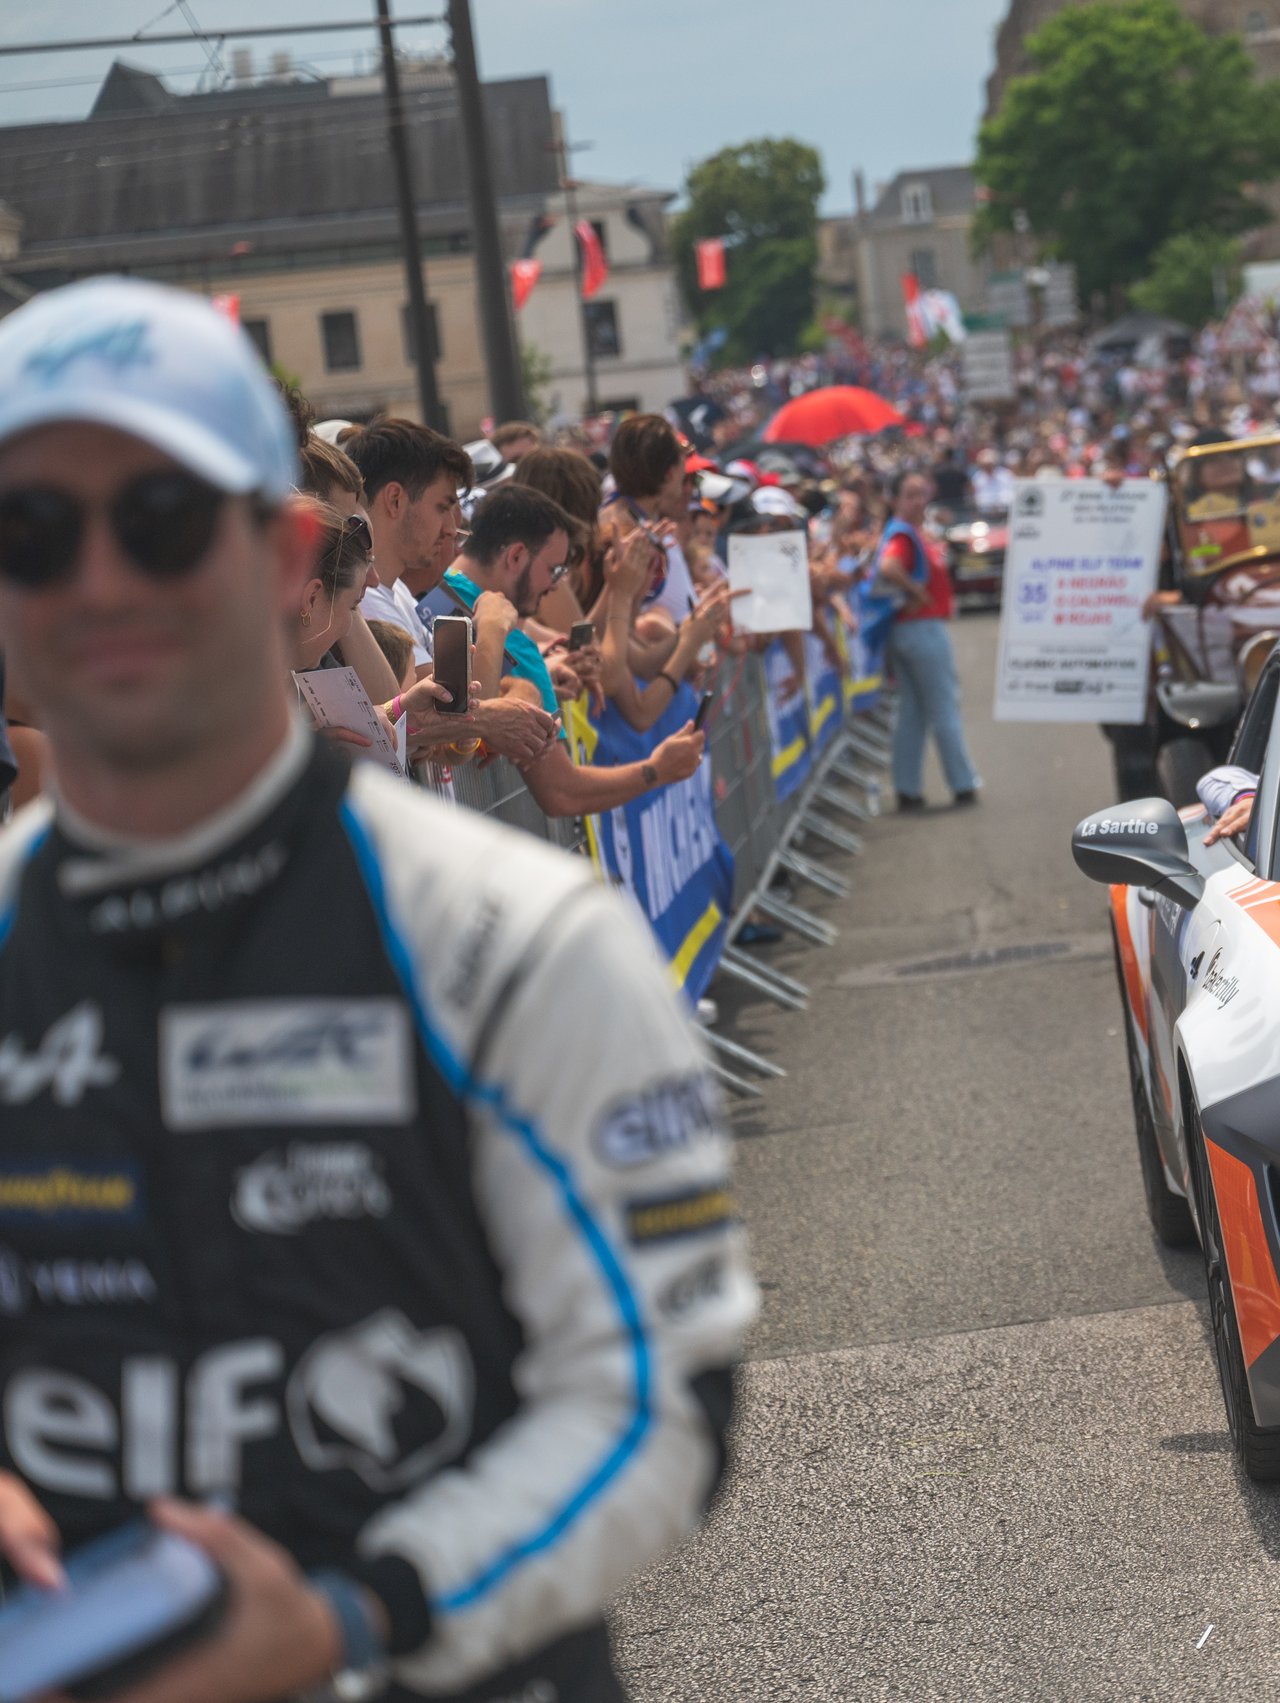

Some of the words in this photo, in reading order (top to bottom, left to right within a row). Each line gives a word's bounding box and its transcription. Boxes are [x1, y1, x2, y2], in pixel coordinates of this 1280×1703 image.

[1081, 821, 1097, 837] La
[1098, 818, 1159, 836] Sarthe
[3, 1337, 284, 1500] elf
